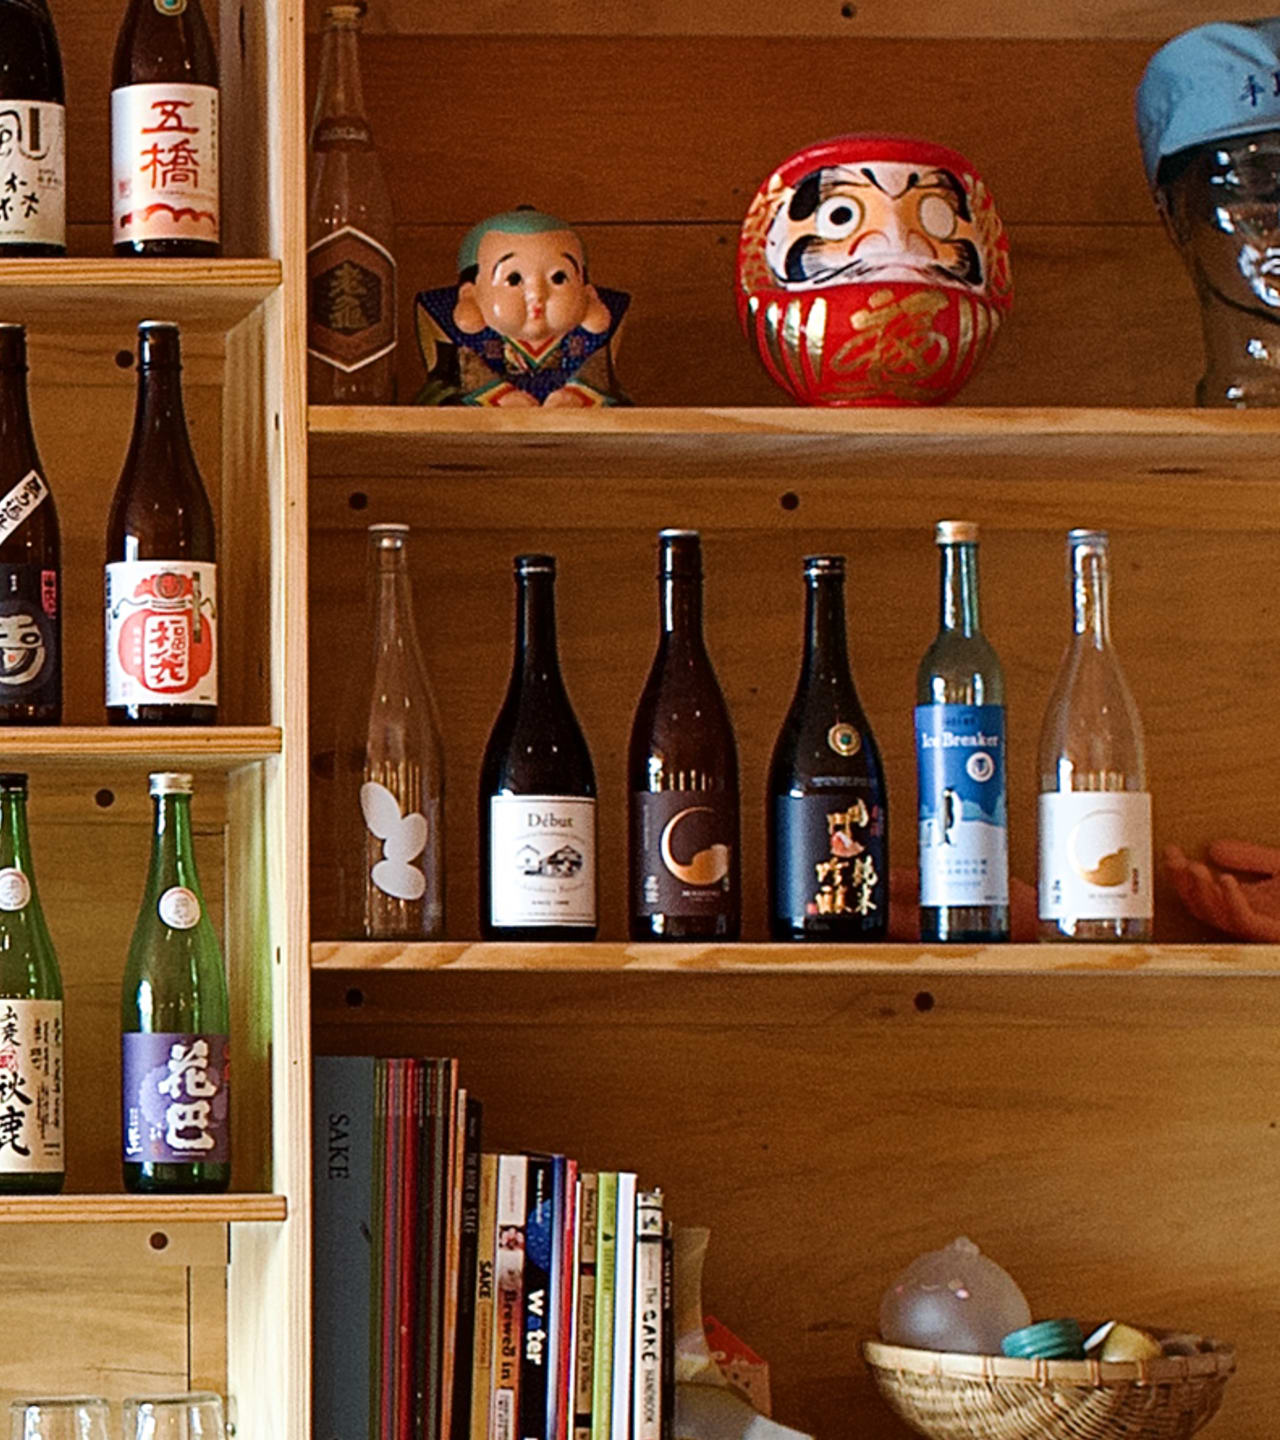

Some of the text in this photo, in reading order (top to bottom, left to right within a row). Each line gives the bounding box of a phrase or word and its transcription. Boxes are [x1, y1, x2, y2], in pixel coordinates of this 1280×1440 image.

[140, 100, 201, 190] 五橋
[921, 731, 1000, 749] Ice Breaker
[527, 812, 574, 829] Début
[327, 1113, 351, 1181] SAKE
[477, 1259, 493, 1299] SAKE
[500, 1289, 518, 1357] Brewed
[526, 1288, 547, 1367] Water
[499, 1361, 516, 1380] in
